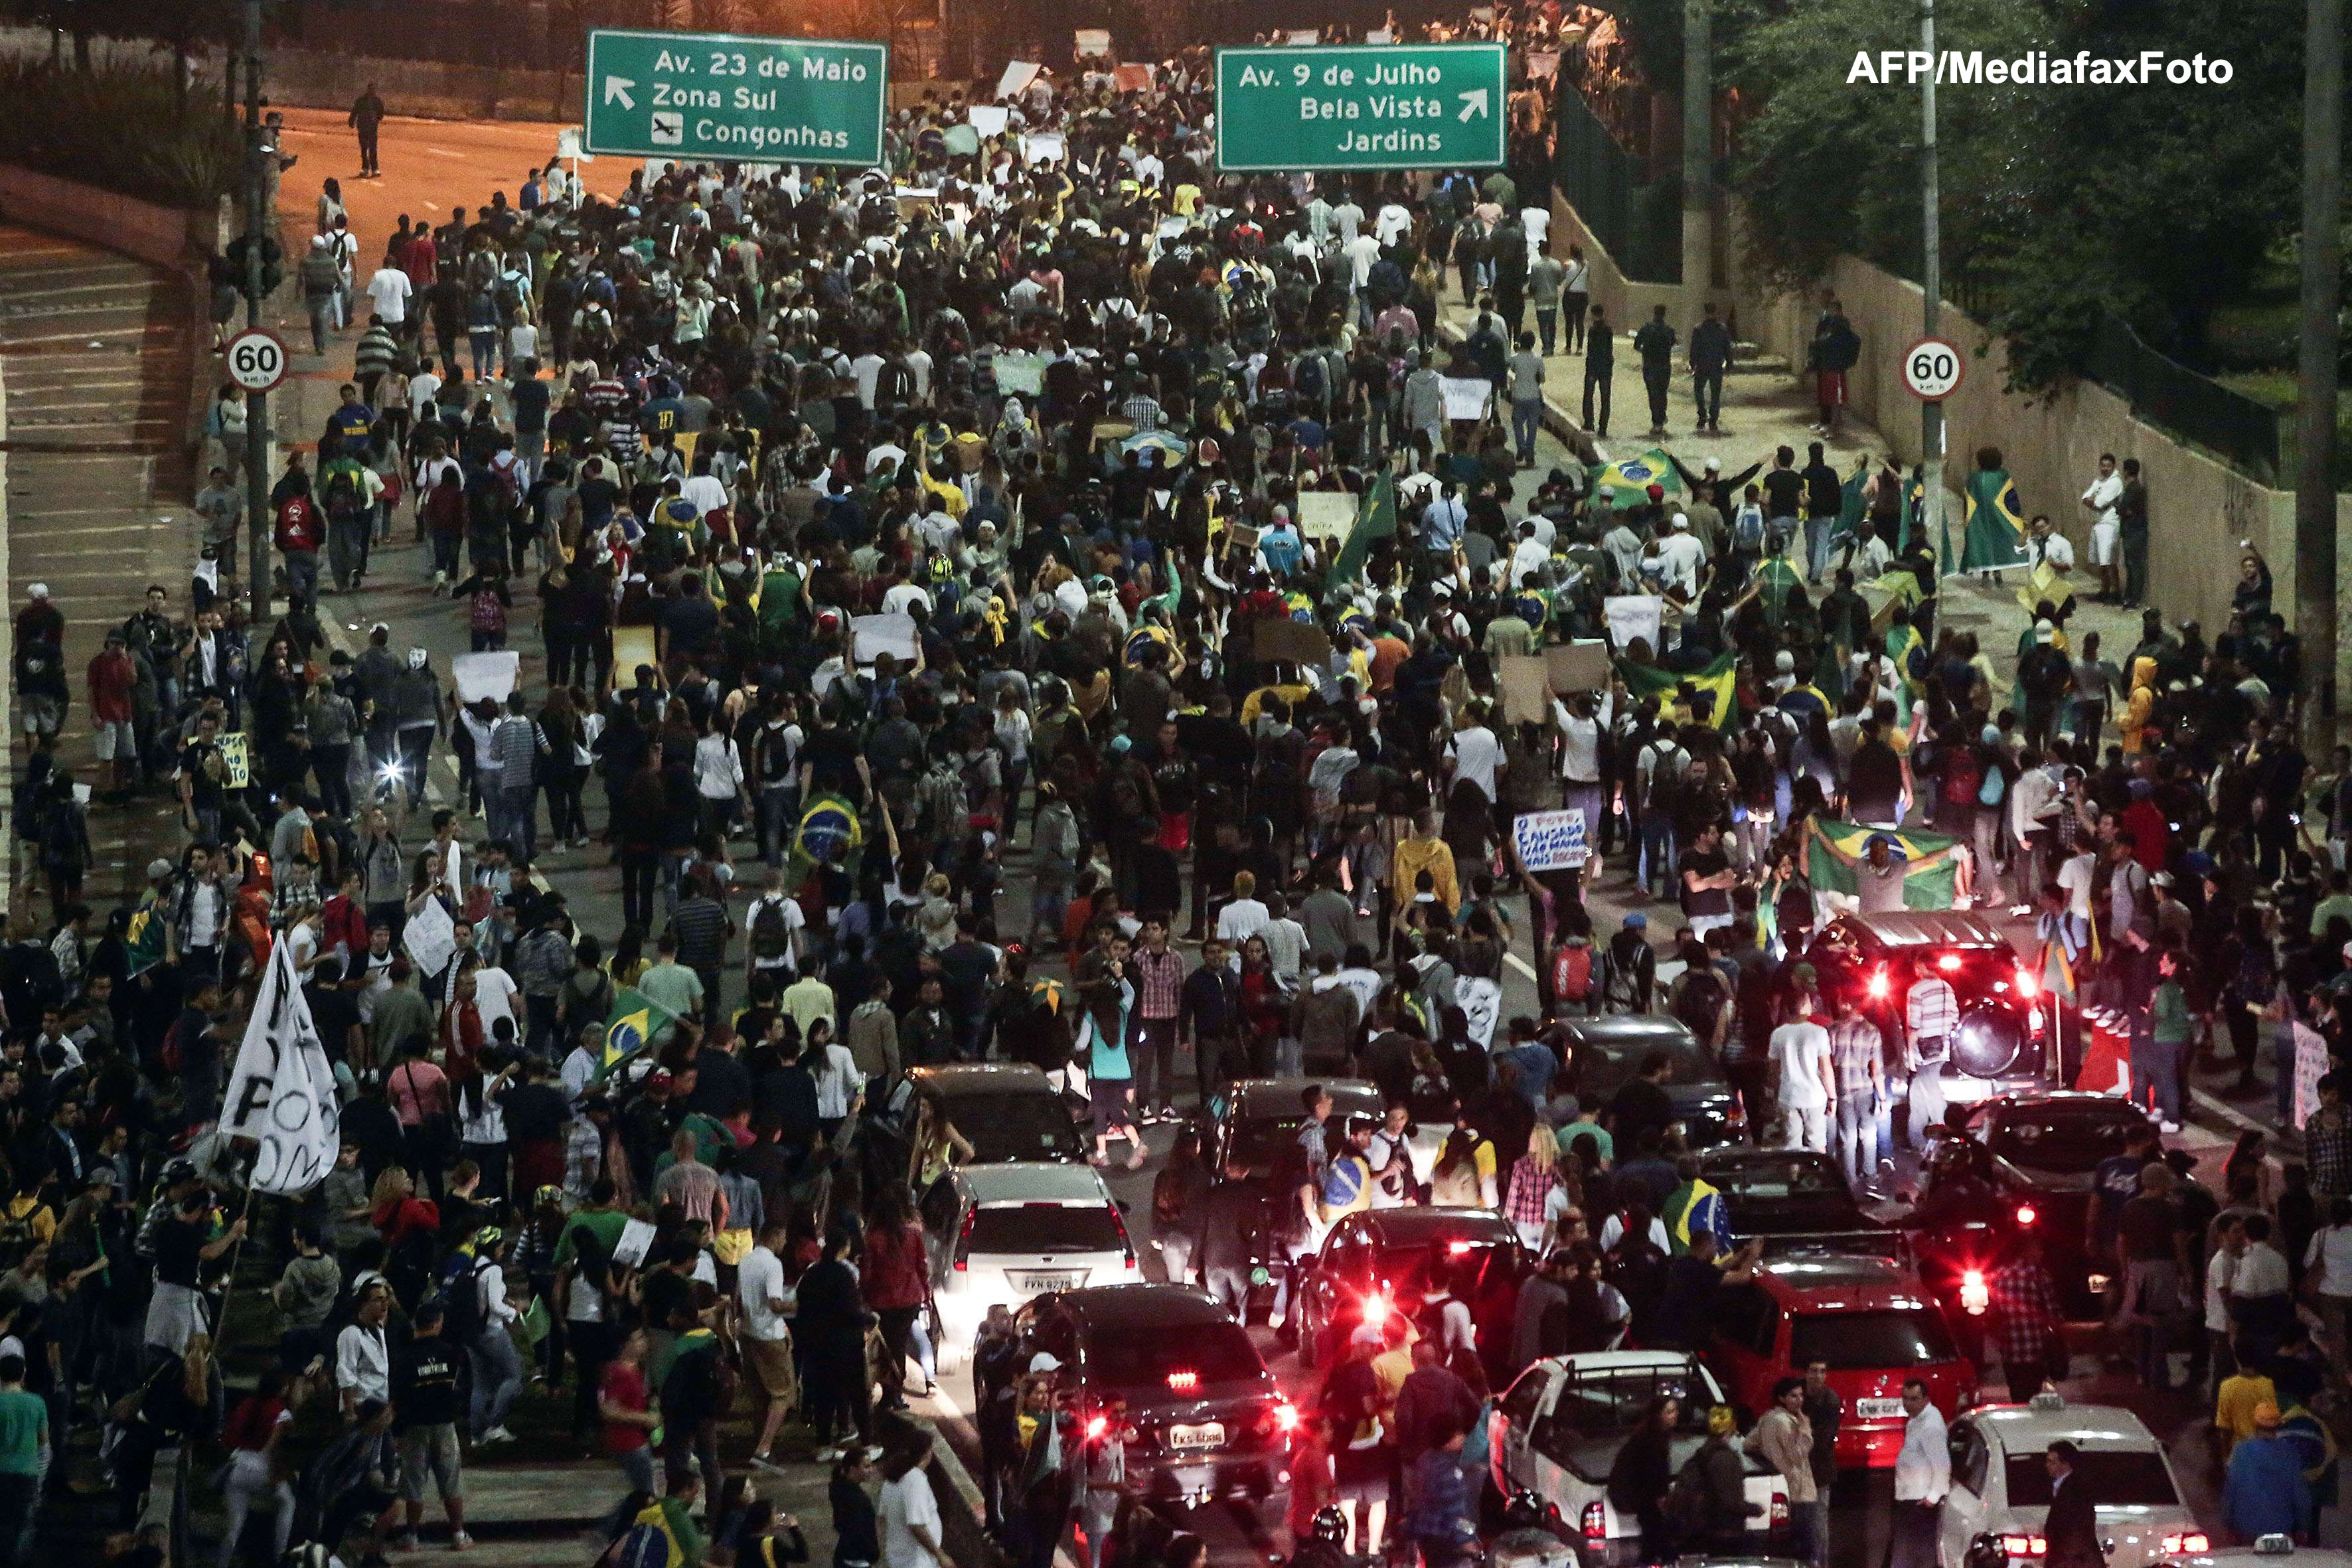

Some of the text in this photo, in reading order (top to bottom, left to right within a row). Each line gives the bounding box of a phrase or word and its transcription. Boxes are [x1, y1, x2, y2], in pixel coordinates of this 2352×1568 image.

[654, 50, 867, 82] Av. 23 de Maio
[1239, 62, 1441, 87] Av. 9 de Julho
[652, 84, 777, 112] Zona Sul
[1300, 94, 1442, 120] Bela Vista
[696, 118, 849, 151] Congonhas
[1337, 129, 1442, 152] Jardins
[236, 344, 277, 373] 60
[1913, 353, 1953, 380] 60
